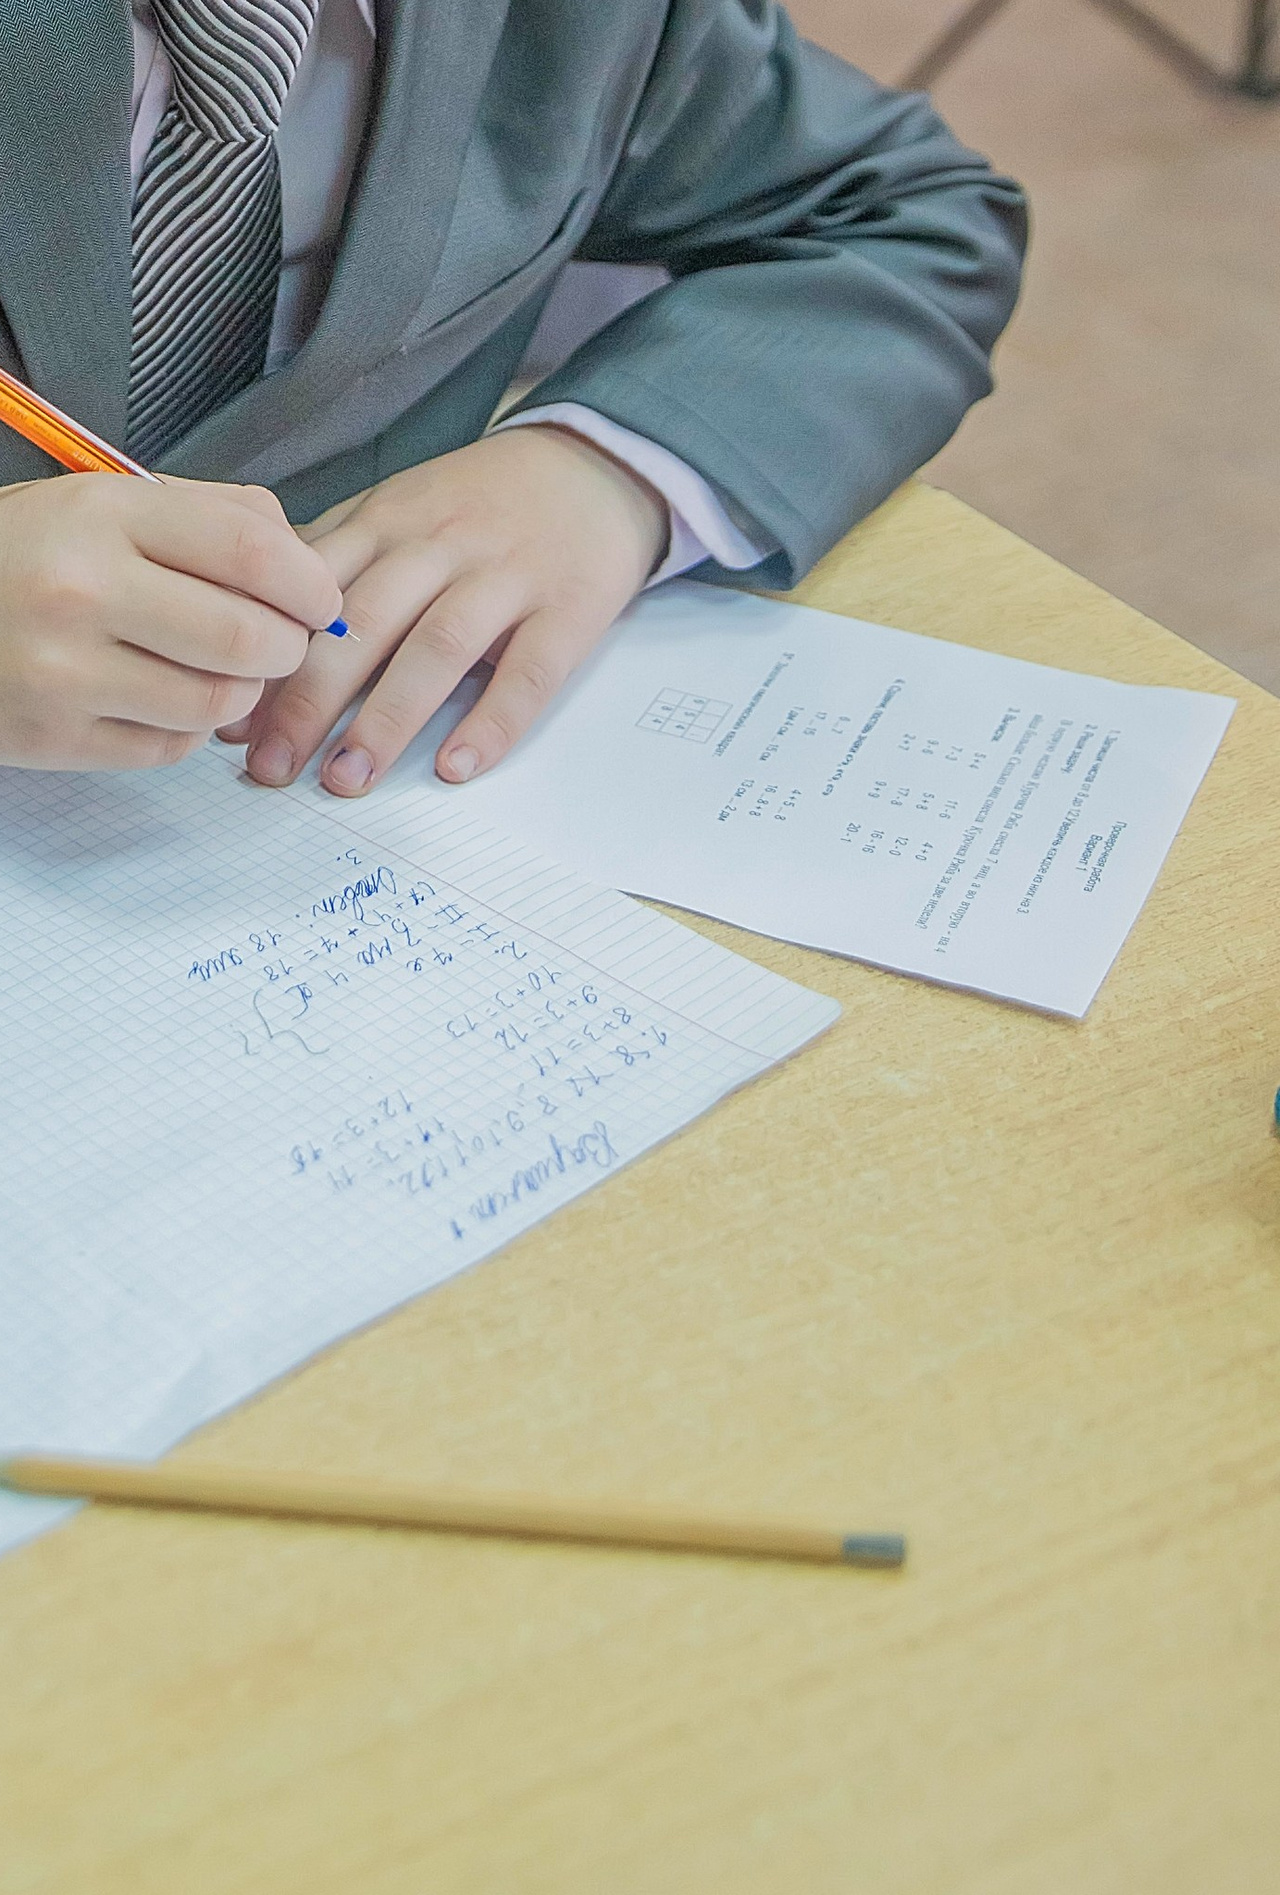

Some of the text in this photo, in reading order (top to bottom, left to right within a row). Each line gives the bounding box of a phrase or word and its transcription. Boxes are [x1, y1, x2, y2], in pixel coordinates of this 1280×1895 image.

[1013, 781, 1040, 811] Курочка
[974, 799, 994, 823] снесла
[1003, 812, 1023, 830] Ряба
[955, 825, 983, 857] Курочка
[989, 831, 1009, 856] снесла
[1079, 834, 1103, 865] Вариант
[335, 848, 361, 865] 3.
[1038, 848, 1057, 874] каждое
[1083, 821, 1127, 892] Проверочная работа
[945, 857, 966, 875] Ряба
[940, 876, 952, 884] за
[1033, 874, 1044, 883] из
[932, 884, 946, 899] две
[965, 889, 977, 900] во
[1026, 883, 1039, 897] них
[1020, 897, 1032, 907] на
[915, 899, 939, 929] недели?
[948, 901, 971, 929] вторую
[937, 936, 950, 946] на
